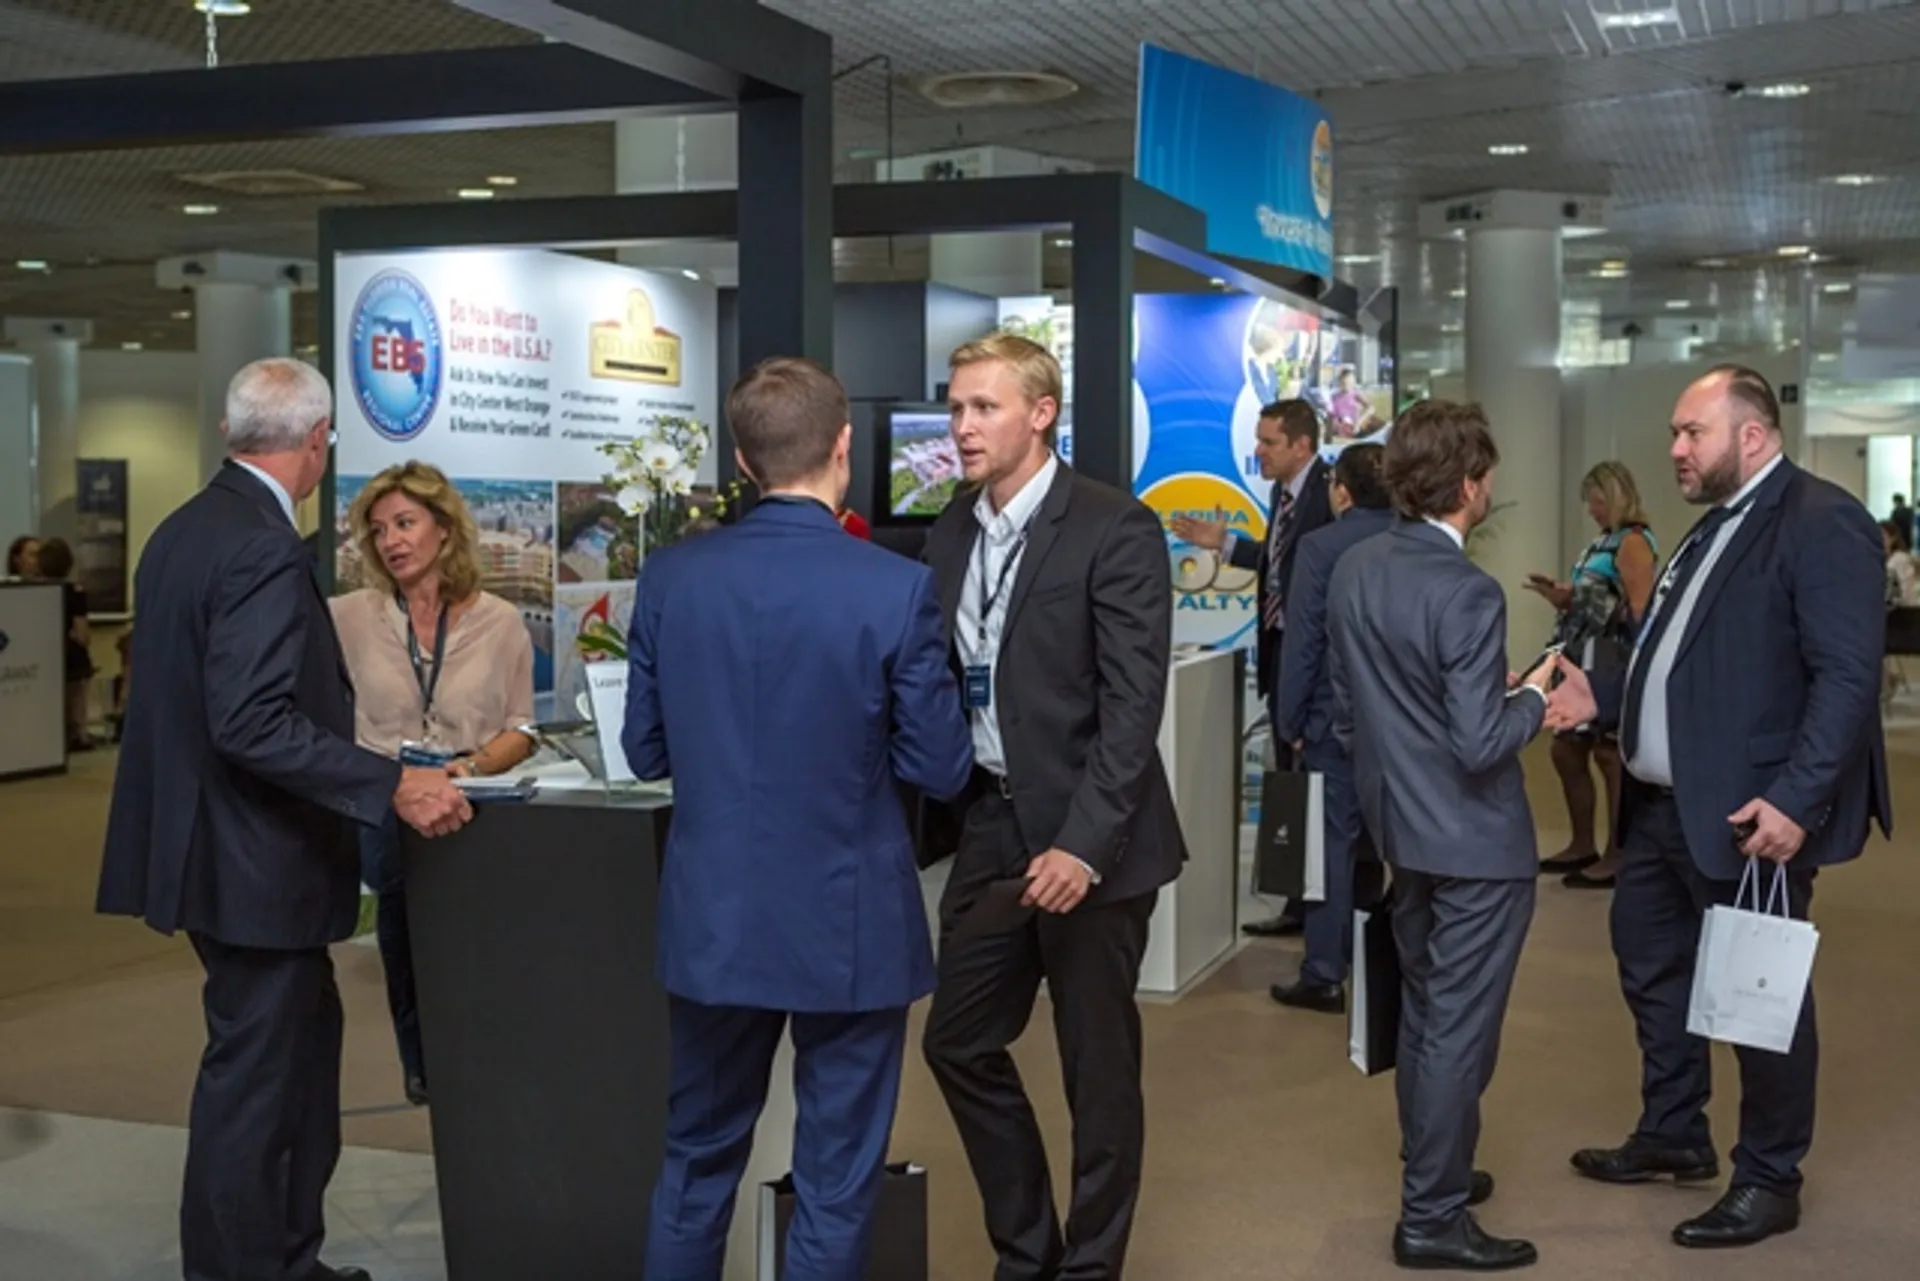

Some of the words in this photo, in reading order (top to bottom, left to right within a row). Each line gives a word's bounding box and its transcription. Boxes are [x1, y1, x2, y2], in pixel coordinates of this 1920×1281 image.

[450, 298, 466, 322] Do
[469, 303, 490, 326] You
[493, 305, 523, 331] Want
[525, 313, 538, 333] to
[450, 328, 474, 352] Live
[477, 335, 489, 354] in
[492, 335, 511, 357] the
[371, 335, 426, 374] EB5
[495, 370, 509, 386] You
[510, 372, 524, 388] Can
[459, 391, 475, 412] City
[477, 393, 502, 410] Center
[490, 418, 507, 436] Your
[1177, 592, 1255, 611] ALTY
